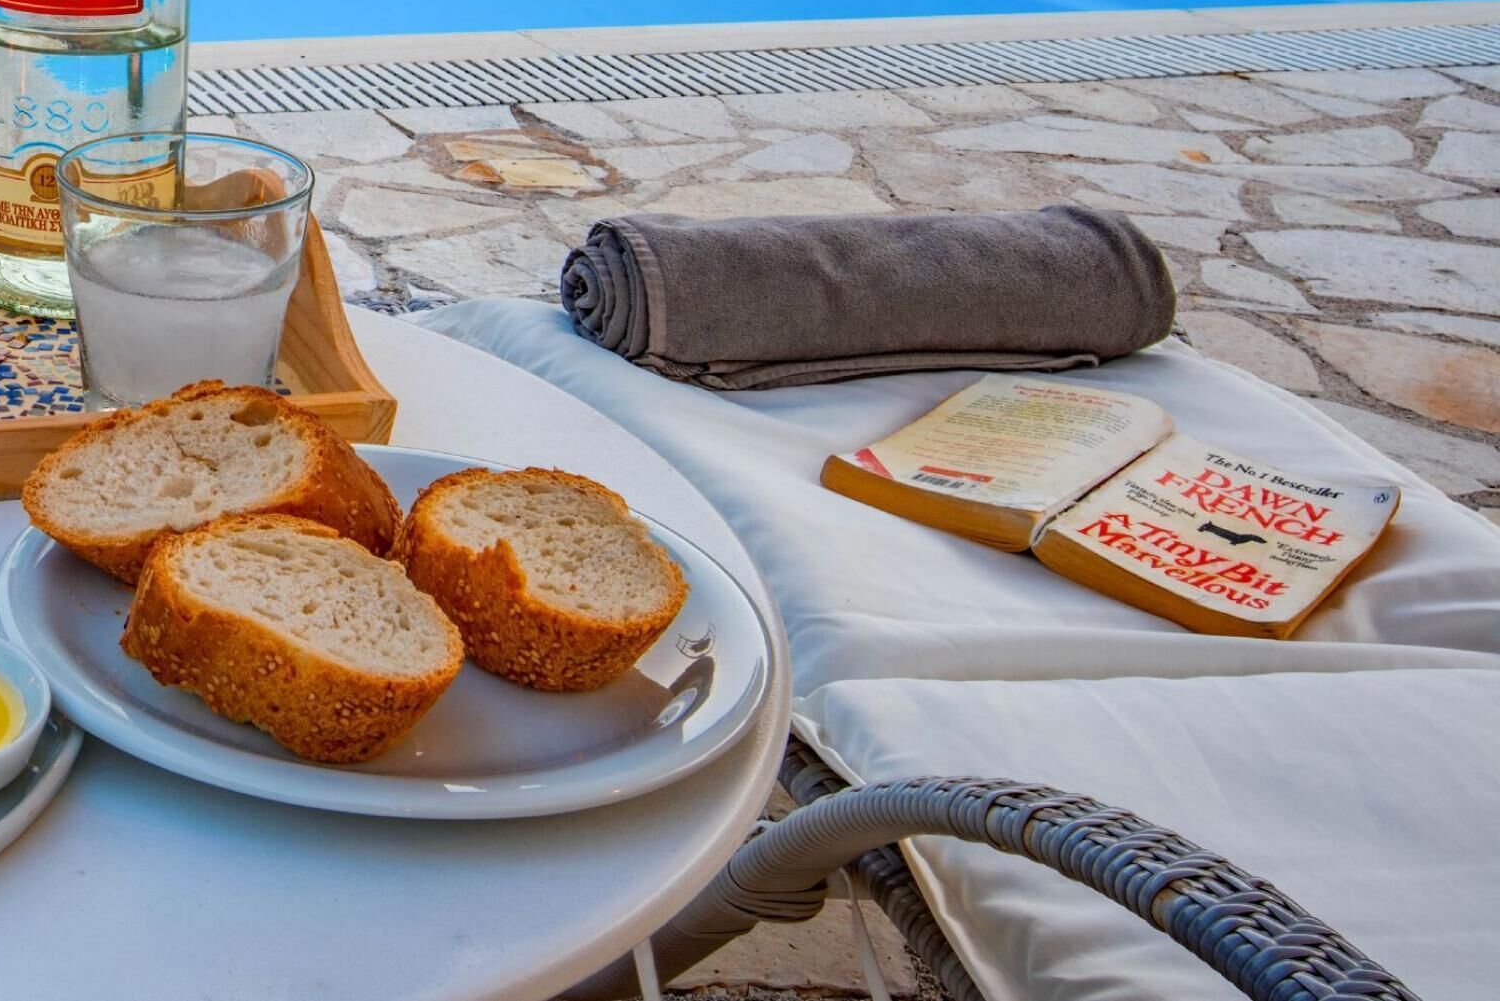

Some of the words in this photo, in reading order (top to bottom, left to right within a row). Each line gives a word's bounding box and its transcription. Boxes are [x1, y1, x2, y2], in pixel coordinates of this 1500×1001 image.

[39, 174, 56, 188] 12
[12, 203, 36, 218] ΤΗΝ
[1194, 467, 1333, 523] DAWN
[1205, 453, 1234, 470] The
[1271, 474, 1344, 500] Bestseller
[1155, 470, 1346, 547] FRENCH
[1077, 519, 1271, 610] Marvellous
[1103, 511, 1133, 531] A
[1135, 521, 1233, 568] Tiny
[1218, 561, 1293, 597] Bit
